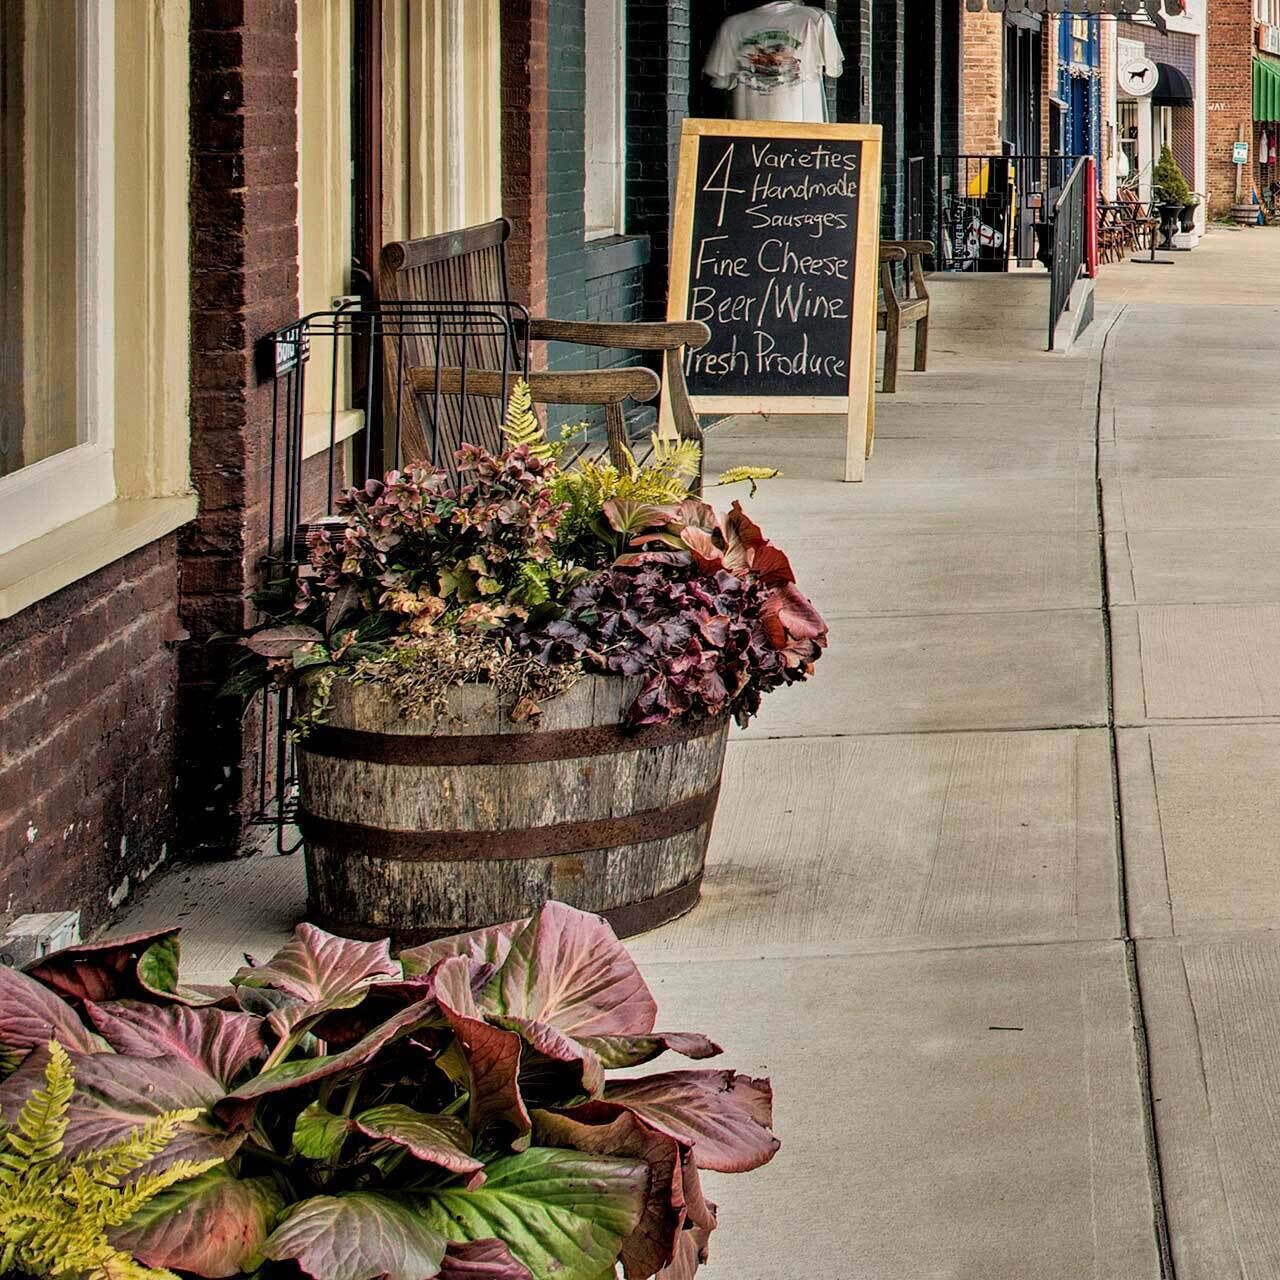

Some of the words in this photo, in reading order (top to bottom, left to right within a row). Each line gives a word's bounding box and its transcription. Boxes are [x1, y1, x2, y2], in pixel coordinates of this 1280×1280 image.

[702, 143, 746, 227] 4
[752, 143, 857, 170] Varieties
[751, 173, 857, 202] Handmade
[745, 204, 848, 238] Sausages
[695, 235, 750, 279] Fine
[757, 238, 848, 279] Cheese
[691, 277, 848, 327] Beer/Wine
[753, 330, 847, 377] Produce
